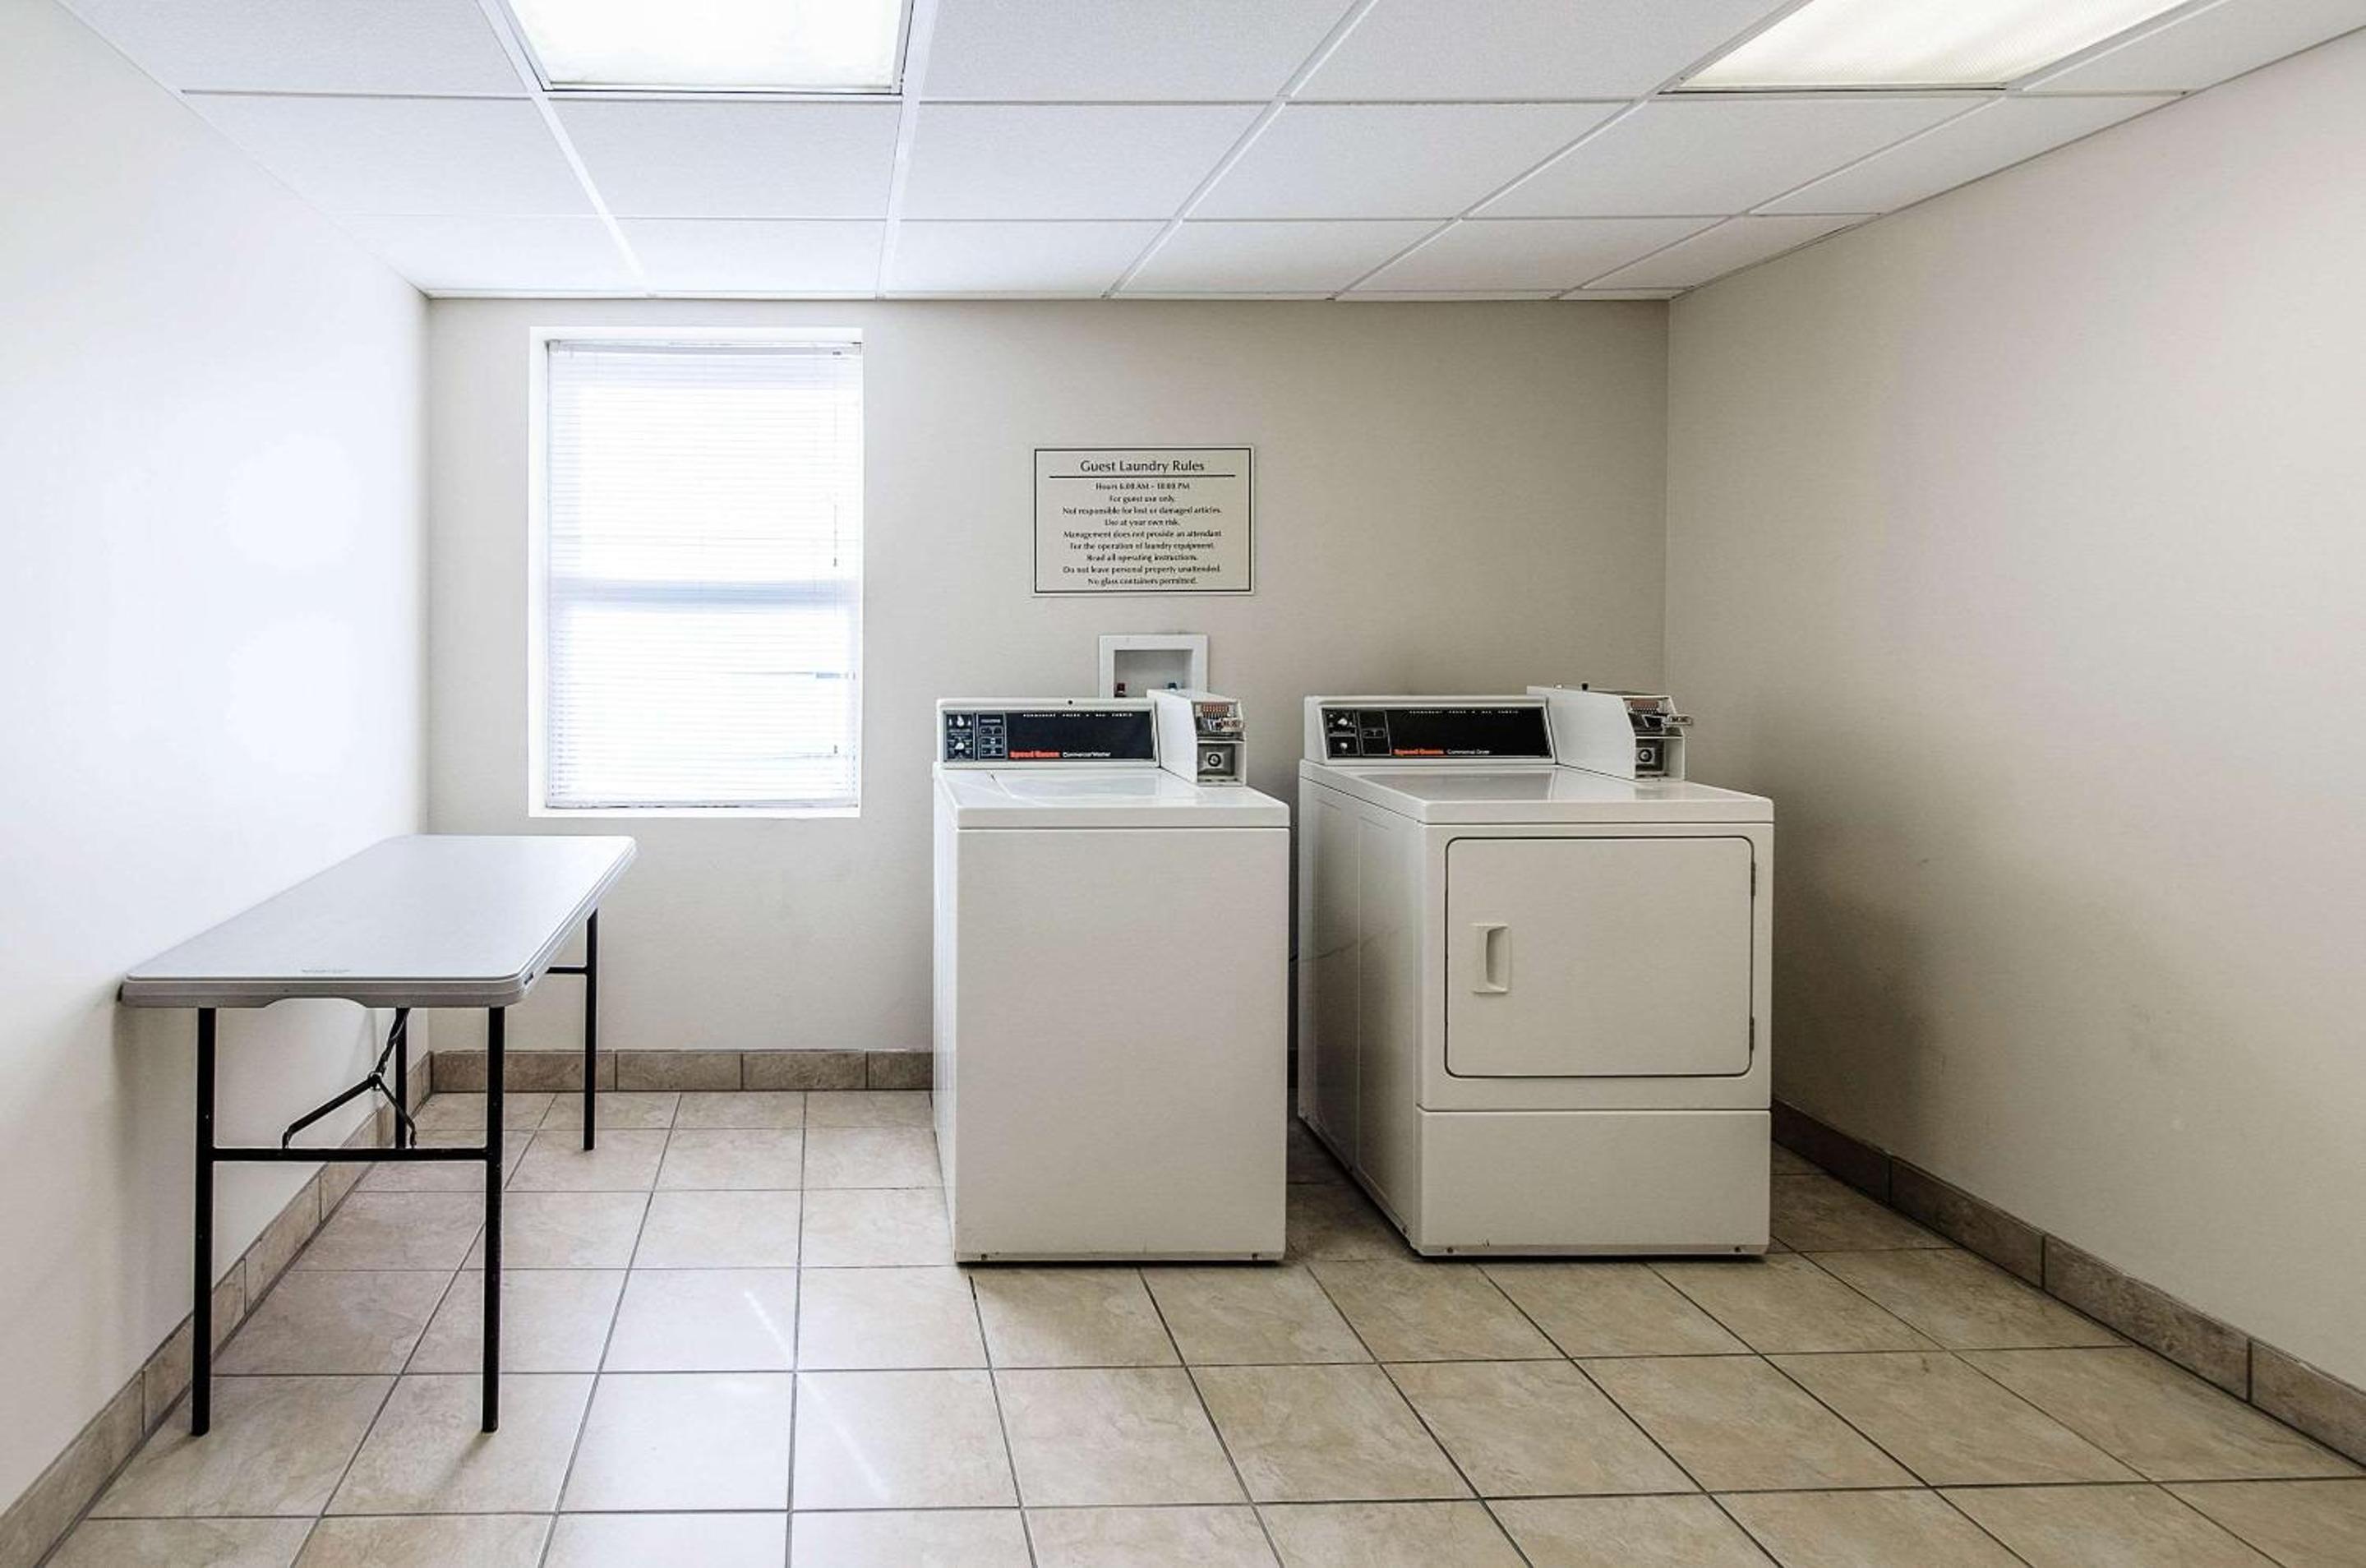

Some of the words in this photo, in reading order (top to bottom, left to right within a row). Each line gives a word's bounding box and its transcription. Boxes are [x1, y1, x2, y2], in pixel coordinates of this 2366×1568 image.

[1081, 460, 1115, 472] Guest
[1120, 460, 1168, 473] Laundry
[1173, 460, 1204, 471] Rules
[1123, 496, 1142, 505] guest
[1078, 506, 1120, 515] responsible
[1159, 506, 1192, 515] damaged
[1129, 520, 1146, 528] your
[1114, 530, 1131, 538] does
[1146, 531, 1174, 539] provide
[1098, 543, 1133, 551] operation
[1145, 542, 1172, 551] laundry
[1118, 554, 1152, 563] operating
[1112, 565, 1142, 574] personal
[1145, 566, 1176, 574] property
[1101, 578, 1118, 587] glass
